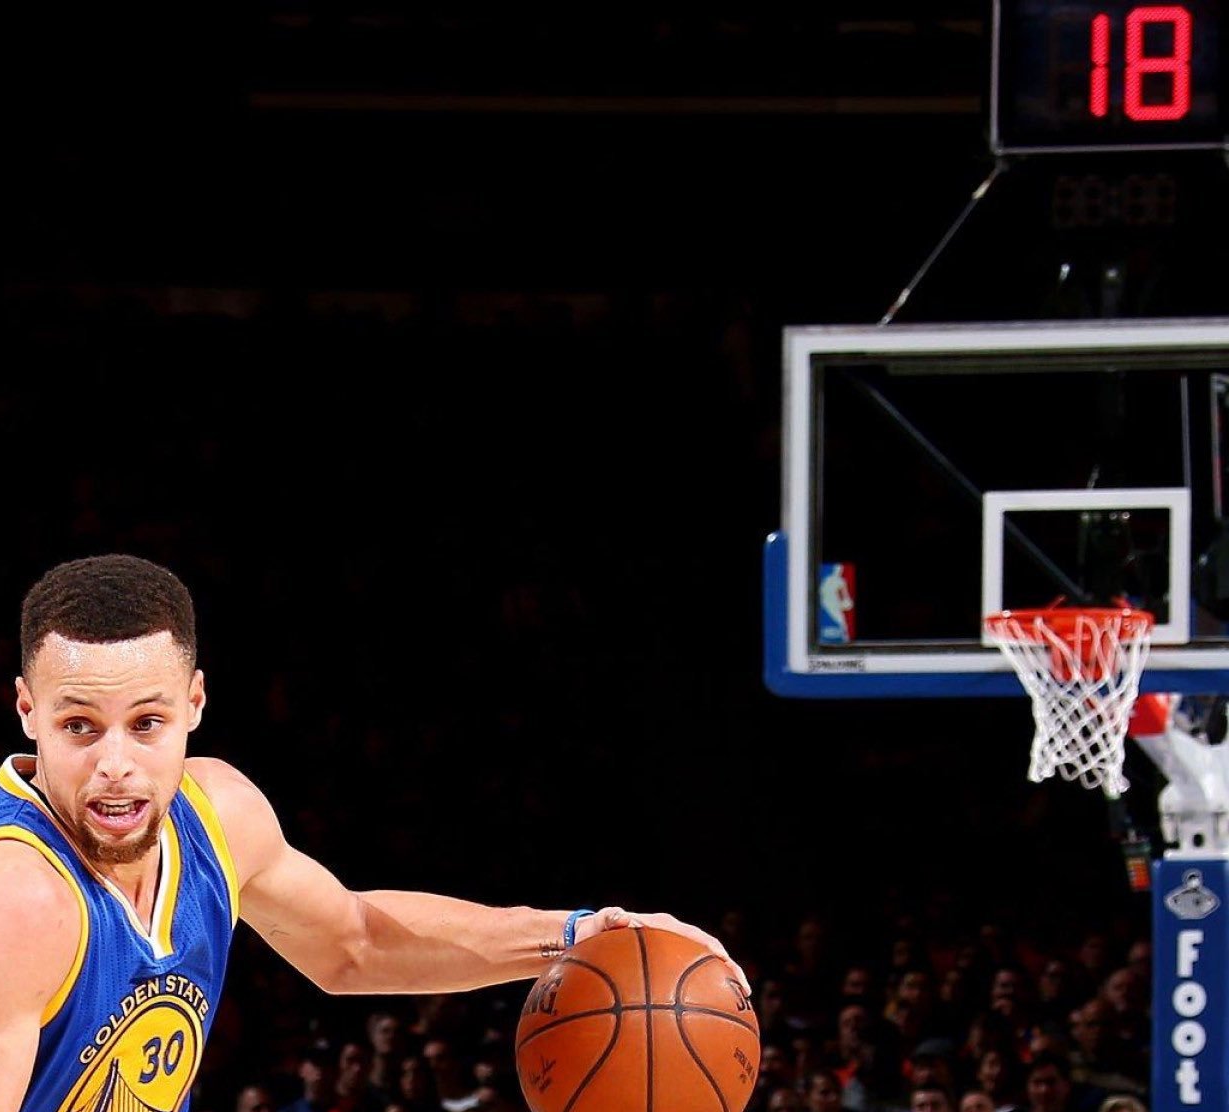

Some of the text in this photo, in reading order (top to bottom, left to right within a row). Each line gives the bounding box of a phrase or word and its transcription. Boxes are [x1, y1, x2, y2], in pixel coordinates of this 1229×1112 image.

[1088, 4, 1193, 122] 18
[79, 974, 209, 1064] GOLDEN STATE
[138, 1029, 185, 1084] 30
